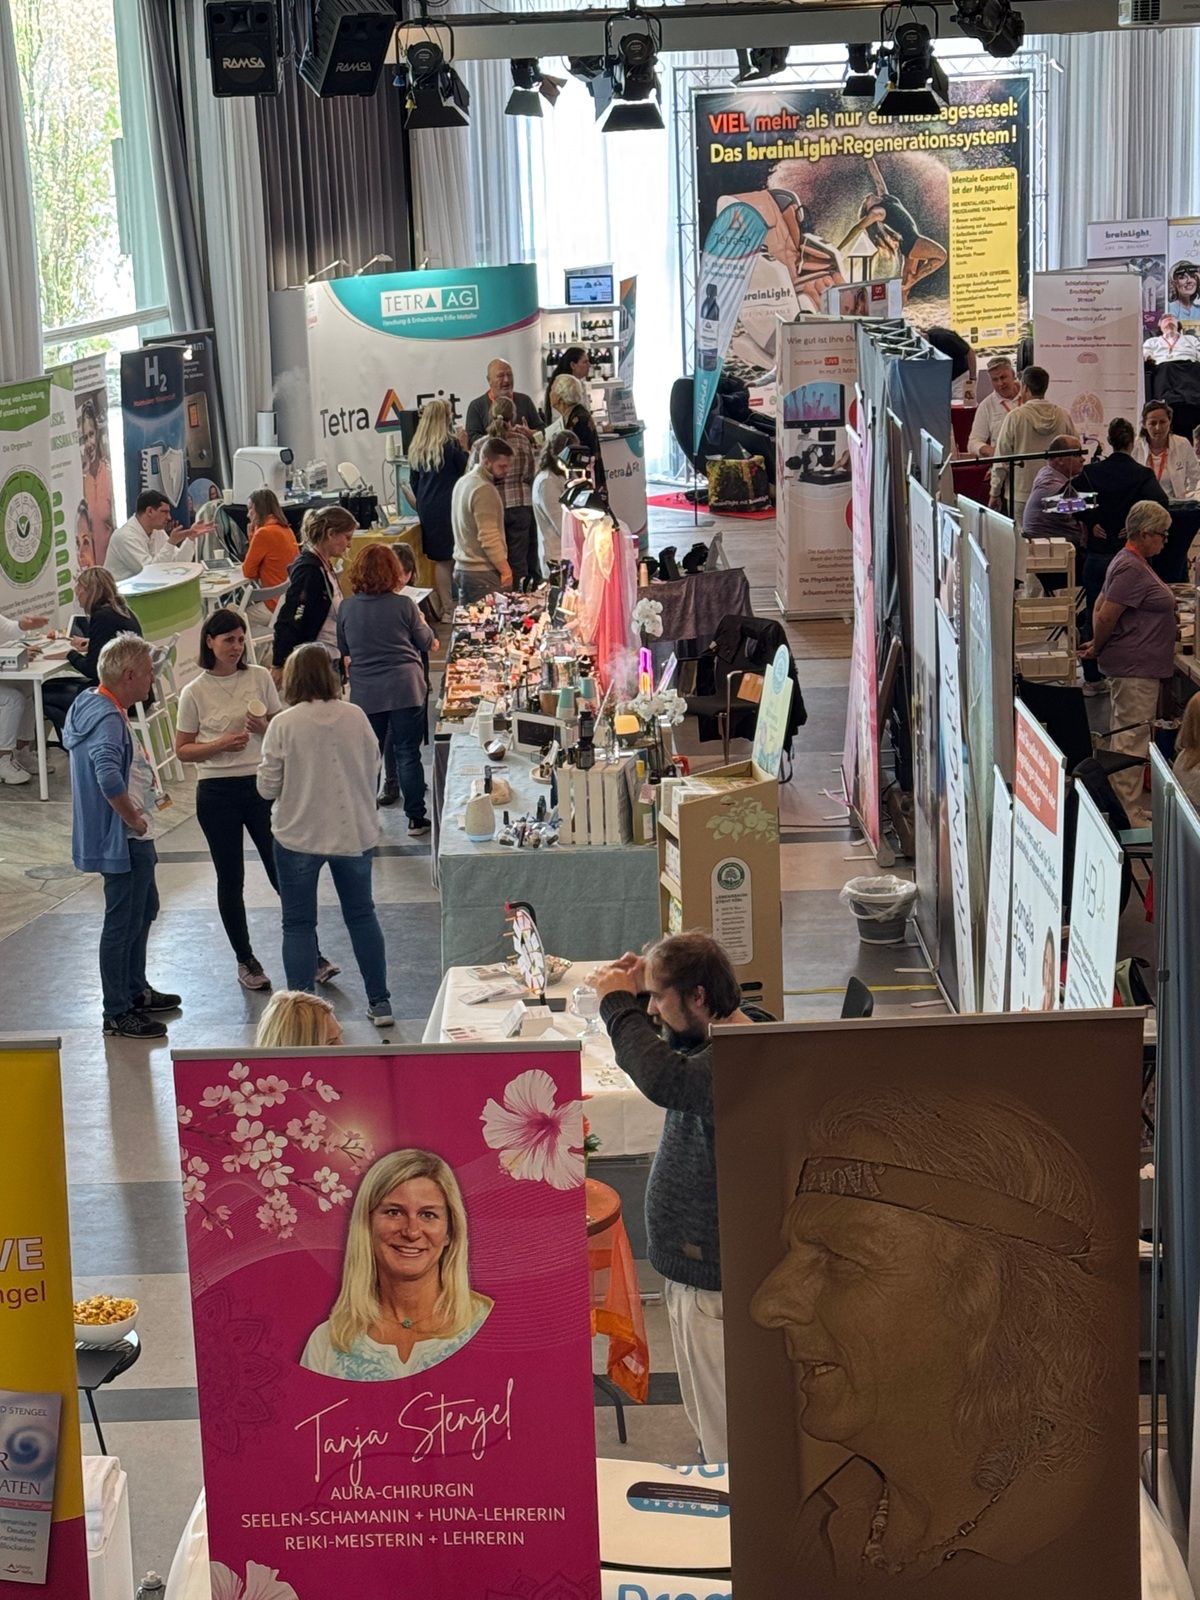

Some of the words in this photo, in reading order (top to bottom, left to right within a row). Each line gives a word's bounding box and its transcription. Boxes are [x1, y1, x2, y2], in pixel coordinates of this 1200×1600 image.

[222, 57, 266, 69] RAMSA
[335, 61, 372, 73] RAMSA
[709, 112, 749, 134] VIEL
[756, 109, 800, 131] mehr
[805, 107, 829, 129] als
[834, 111, 863, 127] nur
[710, 143, 743, 163] Das
[952, 175, 978, 184] Mentale
[979, 172, 1015, 183] Gesundheit
[952, 187, 960, 195] ist
[962, 185, 973, 194] der
[1105, 229, 1150, 239] brainLight
[446, 290, 474, 308] AG
[743, 286, 791, 301] rainLight
[787, 337, 801, 345] Wie
[803, 336, 815, 346] gut
[818, 336, 826, 344] ist
[829, 335, 844, 343] Ihre
[320, 407, 370, 438] Tetra
[9, 1406, 49, 1417] STENGEL
[397, 1377, 514, 1464] Stengel
[294, 1397, 390, 1488] Tanja
[330, 1483, 474, 1501] AURA-CHIRURGIN
[241, 1508, 410, 1529] SEELEN-SCHAMANIN
[415, 1511, 424, 1521] +
[429, 1506, 567, 1523] HUNA-LEHRERIN
[6, 1525, 37, 1537] Deutung
[285, 1532, 424, 1551] REIKI-MEISTERIN
[428, 1535, 438, 1545] +
[443, 1531, 526, 1547] LEHRERIN
